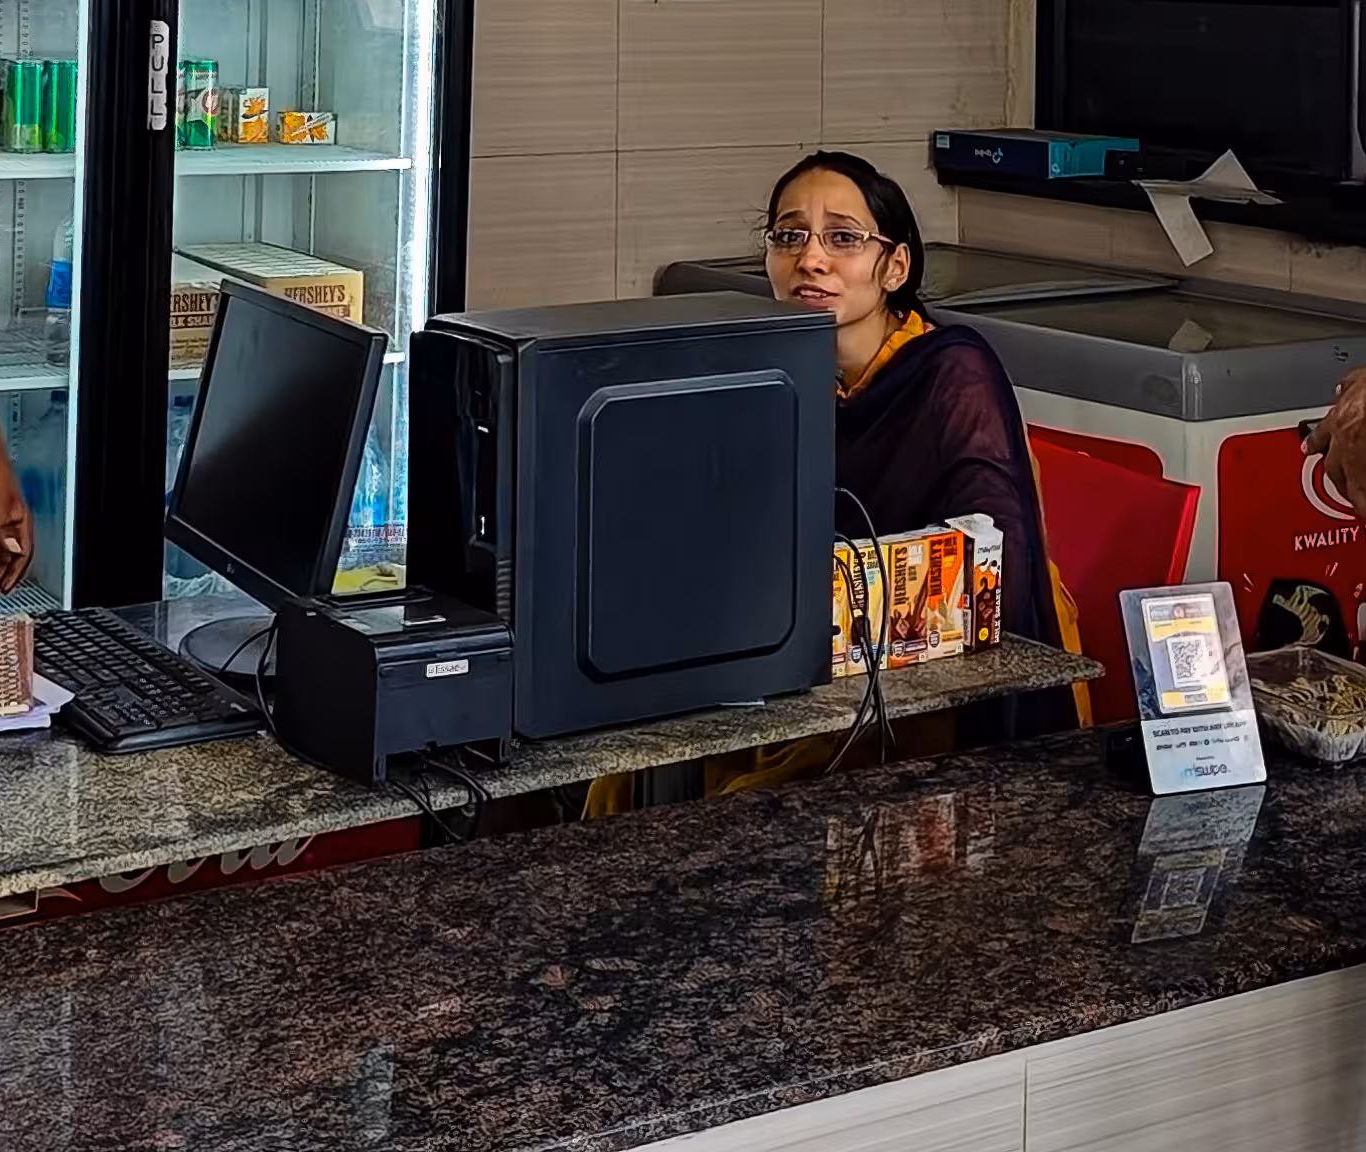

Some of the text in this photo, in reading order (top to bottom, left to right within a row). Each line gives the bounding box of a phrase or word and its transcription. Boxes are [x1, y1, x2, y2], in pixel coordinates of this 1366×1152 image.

[151, 34, 164, 116] PULL
[1295, 525, 1360, 551] KWALITY
[893, 547, 909, 606] HERSHEY'S
